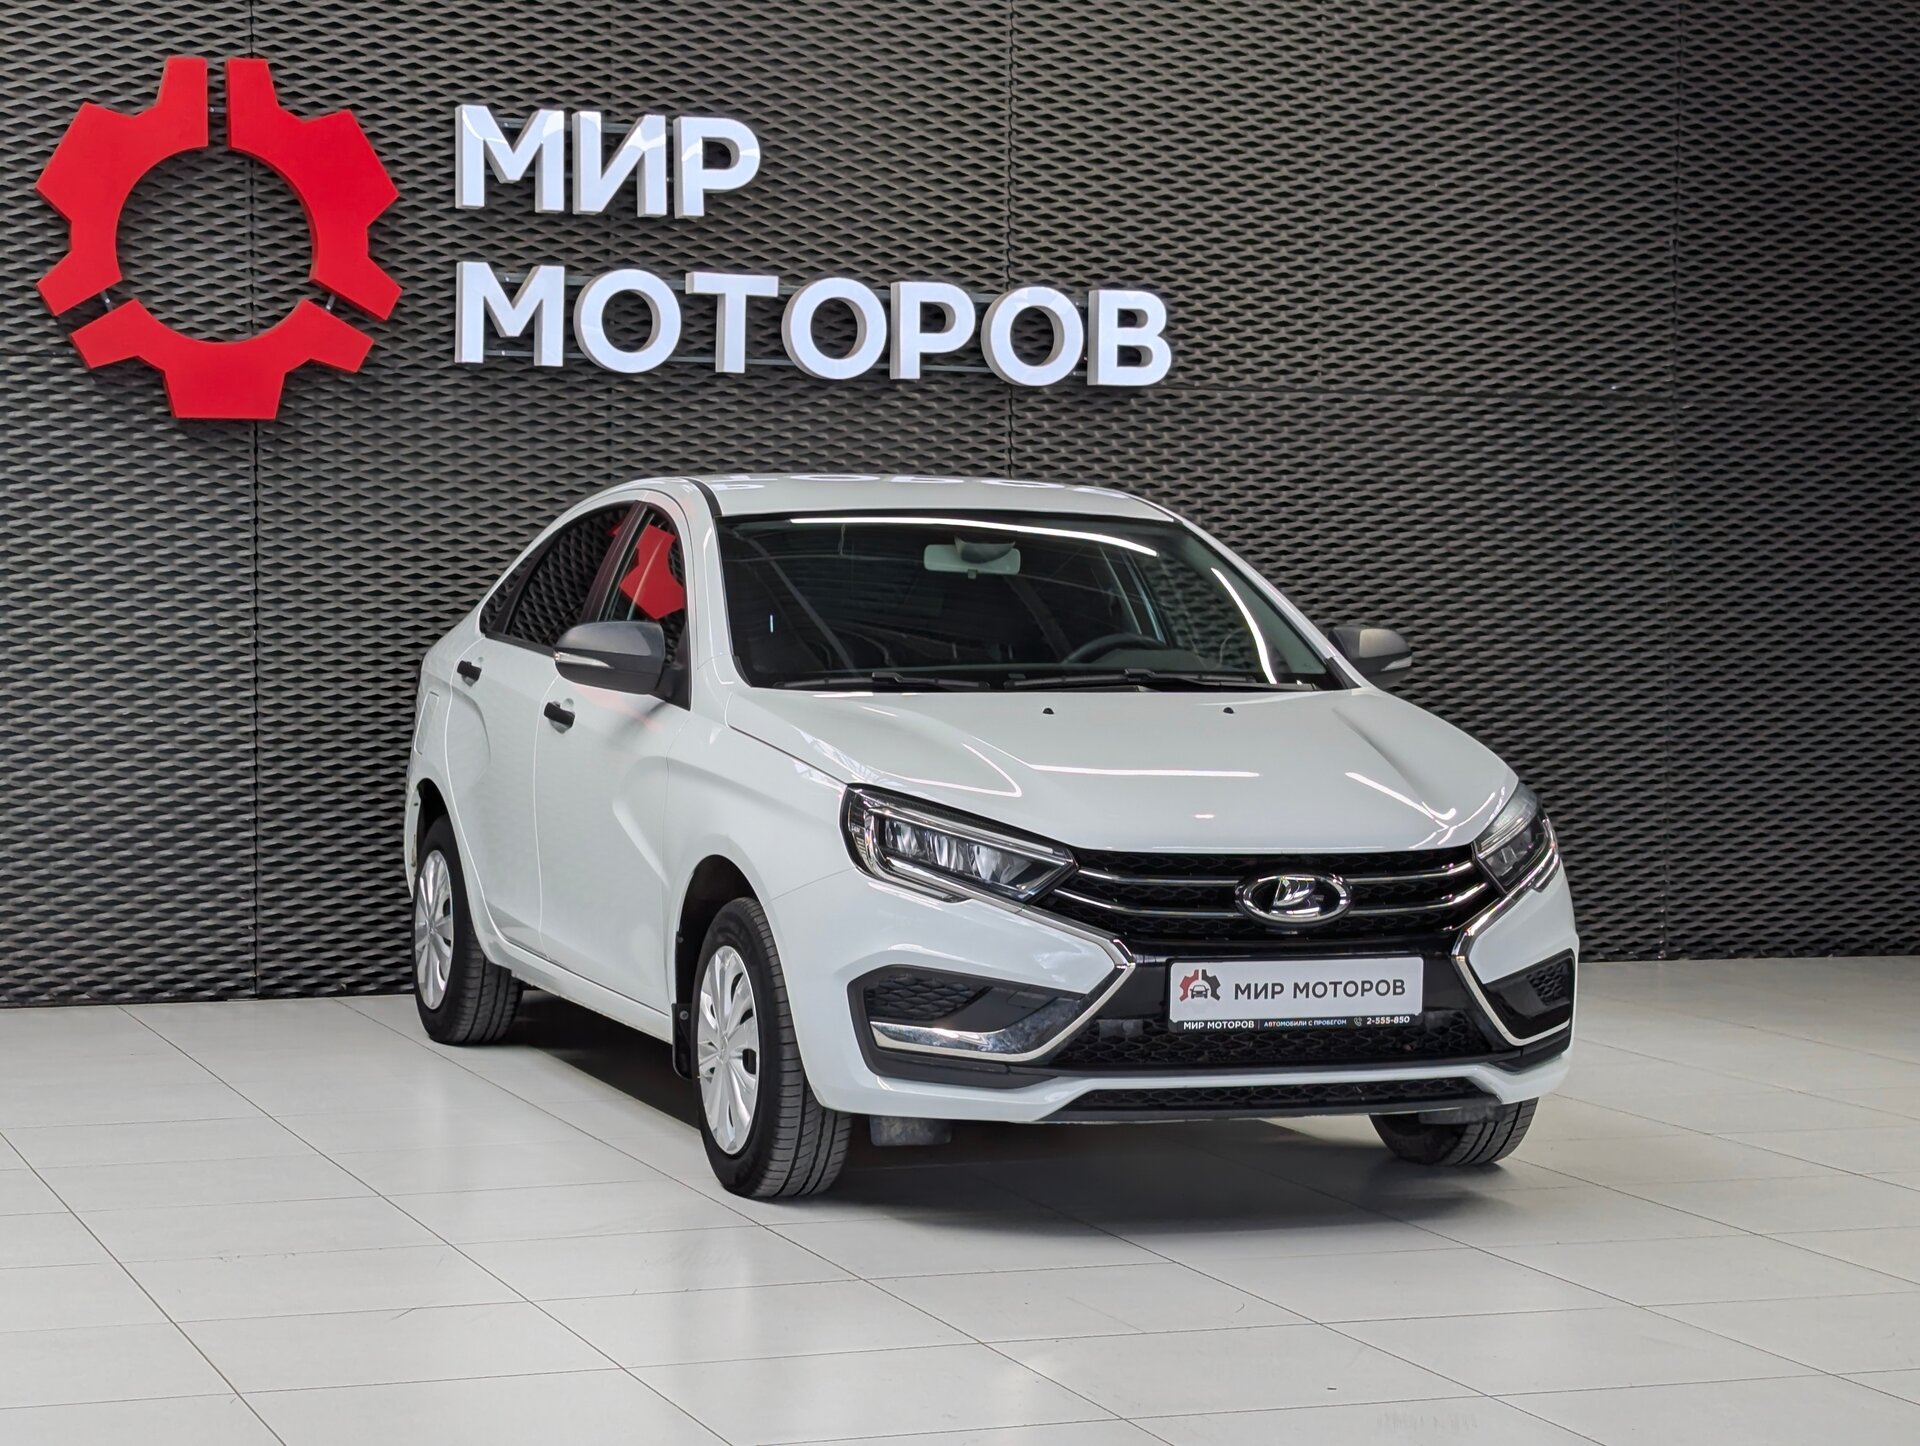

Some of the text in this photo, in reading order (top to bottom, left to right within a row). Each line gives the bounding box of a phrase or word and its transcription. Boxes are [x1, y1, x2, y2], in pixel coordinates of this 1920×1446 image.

[455, 104, 761, 218] МИР
[455, 261, 1172, 386] МОТОРОВ
[1234, 979, 1406, 1000] МИР МОТОРОВ
[1183, 1020, 1255, 1030] МИР МОТОРОВ
[1264, 1019, 1307, 1027] АВТОМОБИЛИ
[1314, 1018, 1347, 1026] ПРОБЕГОМ
[1366, 1015, 1410, 1025] 2-555-850
